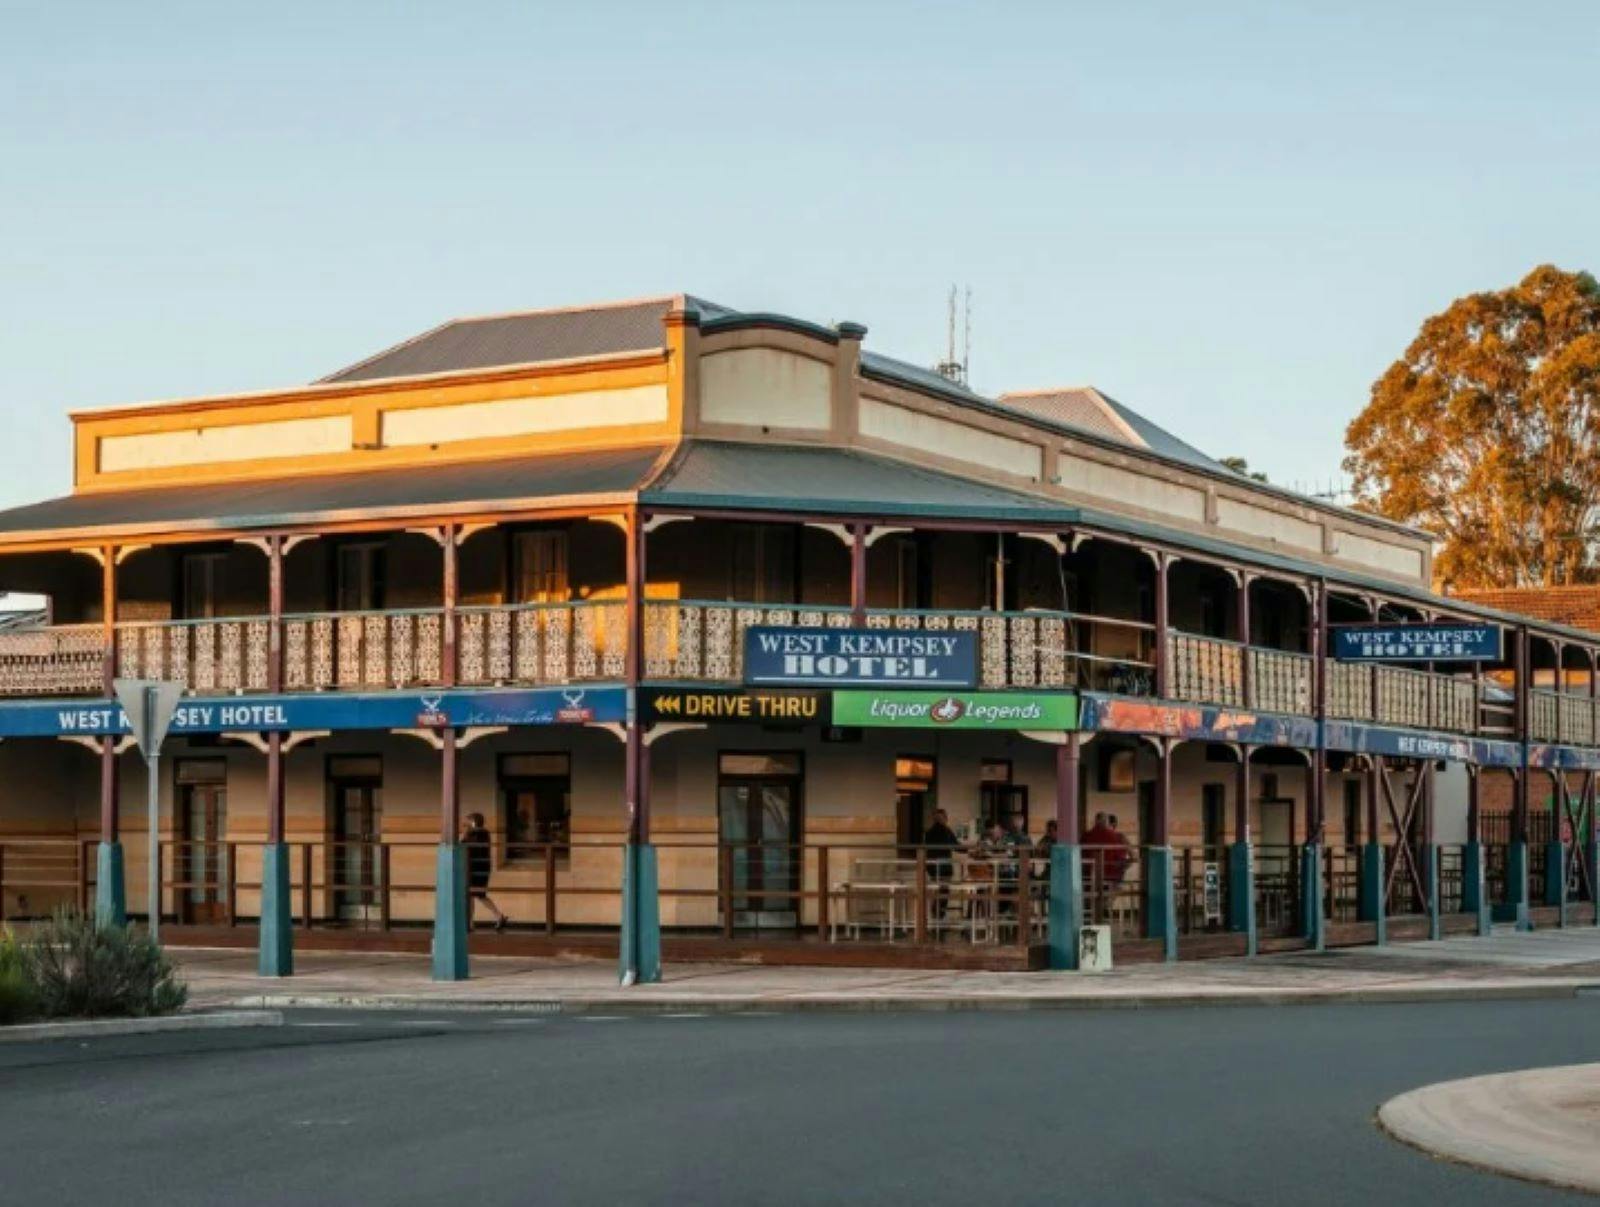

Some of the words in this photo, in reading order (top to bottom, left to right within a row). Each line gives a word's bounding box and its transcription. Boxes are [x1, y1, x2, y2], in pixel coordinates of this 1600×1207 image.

[758, 634, 829, 653] WEST
[839, 636, 958, 656] KEMPSEY
[1344, 632, 1394, 644] WEST
[1400, 630, 1487, 643] KEMPSEY
[1362, 643, 1473, 656] HOTEL
[783, 655, 939, 678] HOTEL
[685, 695, 751, 716] DRIVE
[757, 696, 817, 717] THRU
[871, 699, 931, 721] Liquor
[965, 701, 1041, 723] Legends
[59, 710, 112, 729] WEST
[119, 708, 213, 728] KSEY
[220, 706, 288, 725] HOTEL
